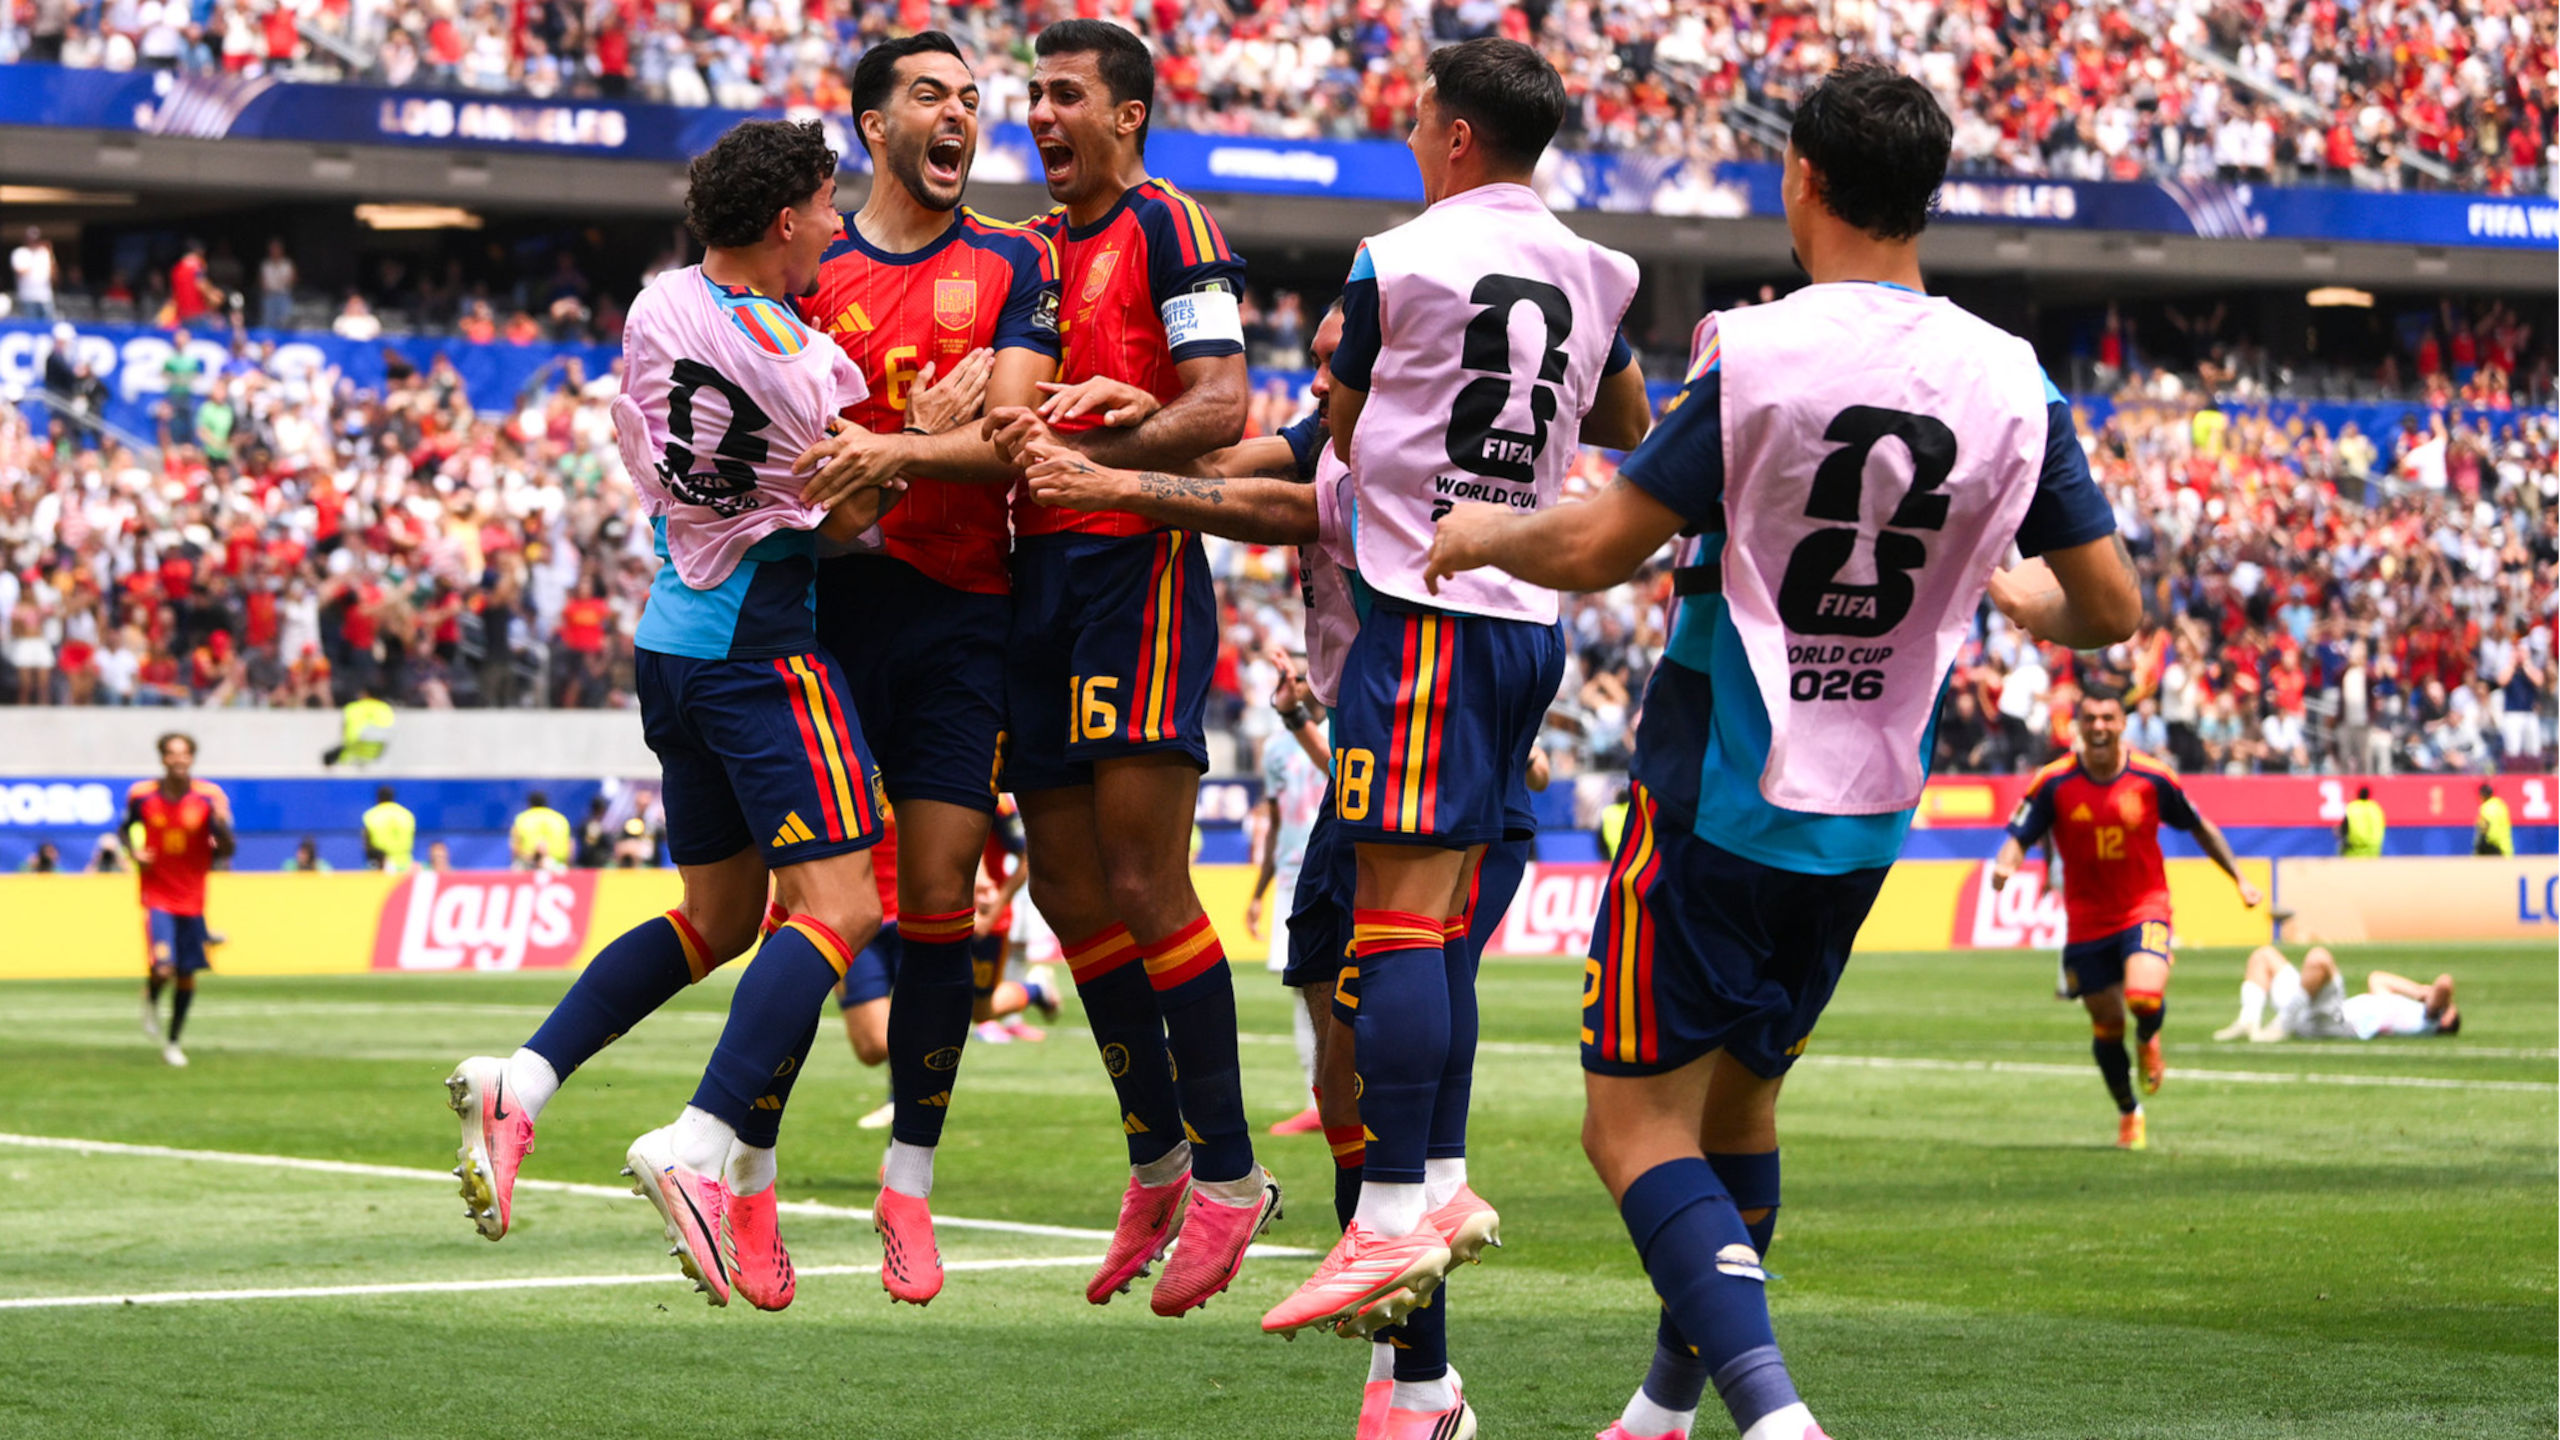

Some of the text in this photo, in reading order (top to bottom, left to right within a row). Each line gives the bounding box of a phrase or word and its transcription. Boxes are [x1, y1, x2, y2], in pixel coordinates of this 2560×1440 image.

[1163, 299, 1194, 315] OTBALL
[1481, 437, 1533, 466] FIFA
[1435, 475, 1508, 504] WORLD
[1816, 592, 1877, 619] FIFA
[1786, 645, 1893, 665] ORLD CUP
[1790, 668, 1885, 703] 026
[1069, 675, 1119, 744] 16
[1335, 747, 1375, 821] 18
[0, 783, 114, 826] 026
[2095, 826, 2125, 860] 12
[398, 870, 576, 971] Lay's
[1502, 861, 1609, 956] Lay
[1971, 858, 2068, 949] Lay
[2141, 921, 2169, 954] 12
